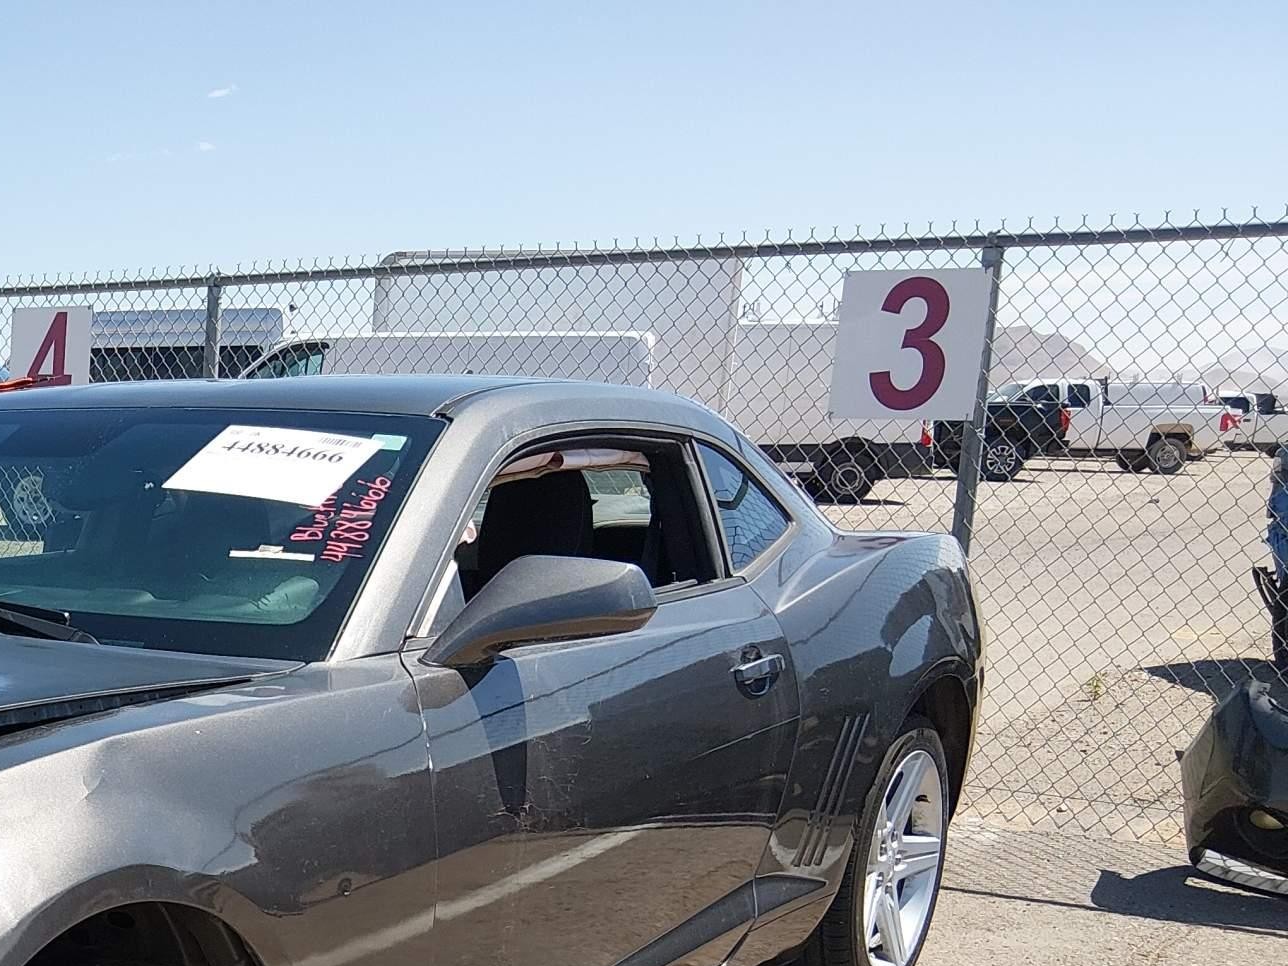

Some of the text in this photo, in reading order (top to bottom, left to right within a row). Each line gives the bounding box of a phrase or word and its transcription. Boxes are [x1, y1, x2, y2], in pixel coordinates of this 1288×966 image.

[26, 311, 72, 386] 4
[869, 276, 950, 411] 3
[222, 439, 345, 464] 44884666
[320, 475, 392, 562] 44884666
